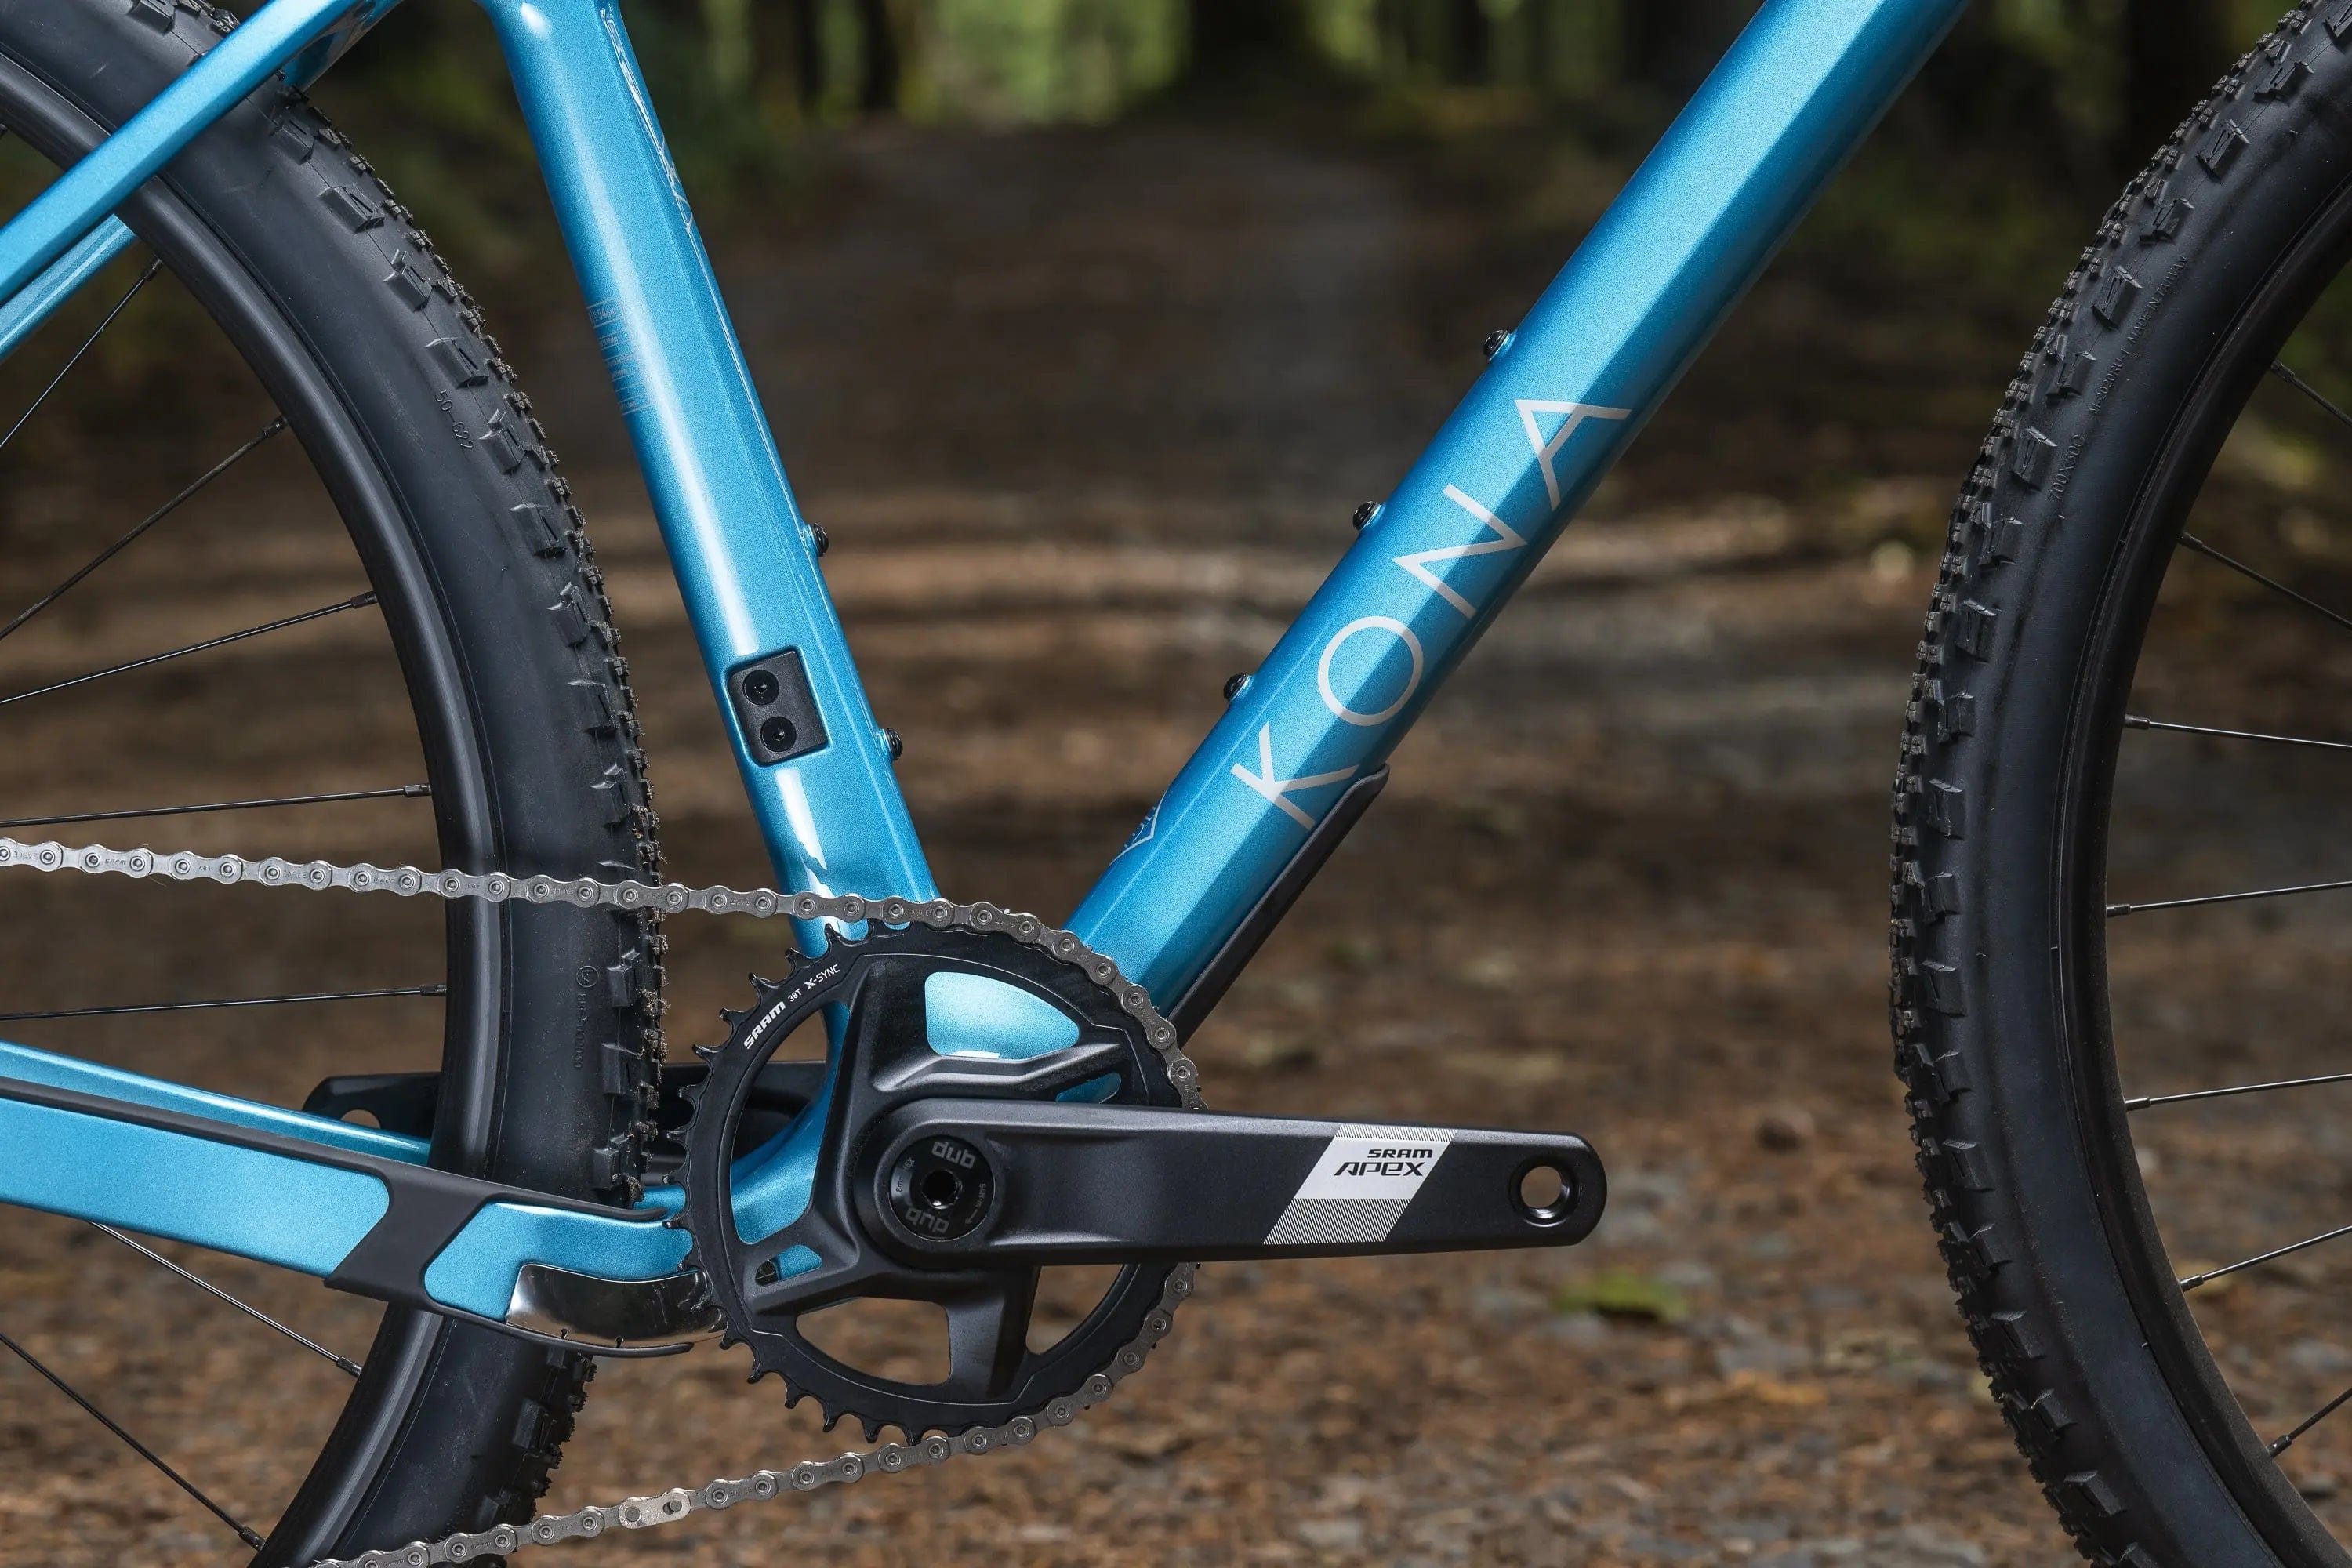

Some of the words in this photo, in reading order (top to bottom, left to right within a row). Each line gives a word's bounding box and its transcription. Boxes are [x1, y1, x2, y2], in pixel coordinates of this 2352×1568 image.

[434, 390, 474, 449] 50-622
[1232, 399, 1632, 831] KONA
[743, 1001, 786, 1050] SRAM
[787, 988, 803, 1002] 38T
[804, 964, 840, 989] X-SYNC
[931, 1141, 976, 1169] dub
[1367, 1149, 1433, 1159] SRAM
[1334, 1161, 1425, 1177] APEX
[904, 1207, 949, 1234] dub
